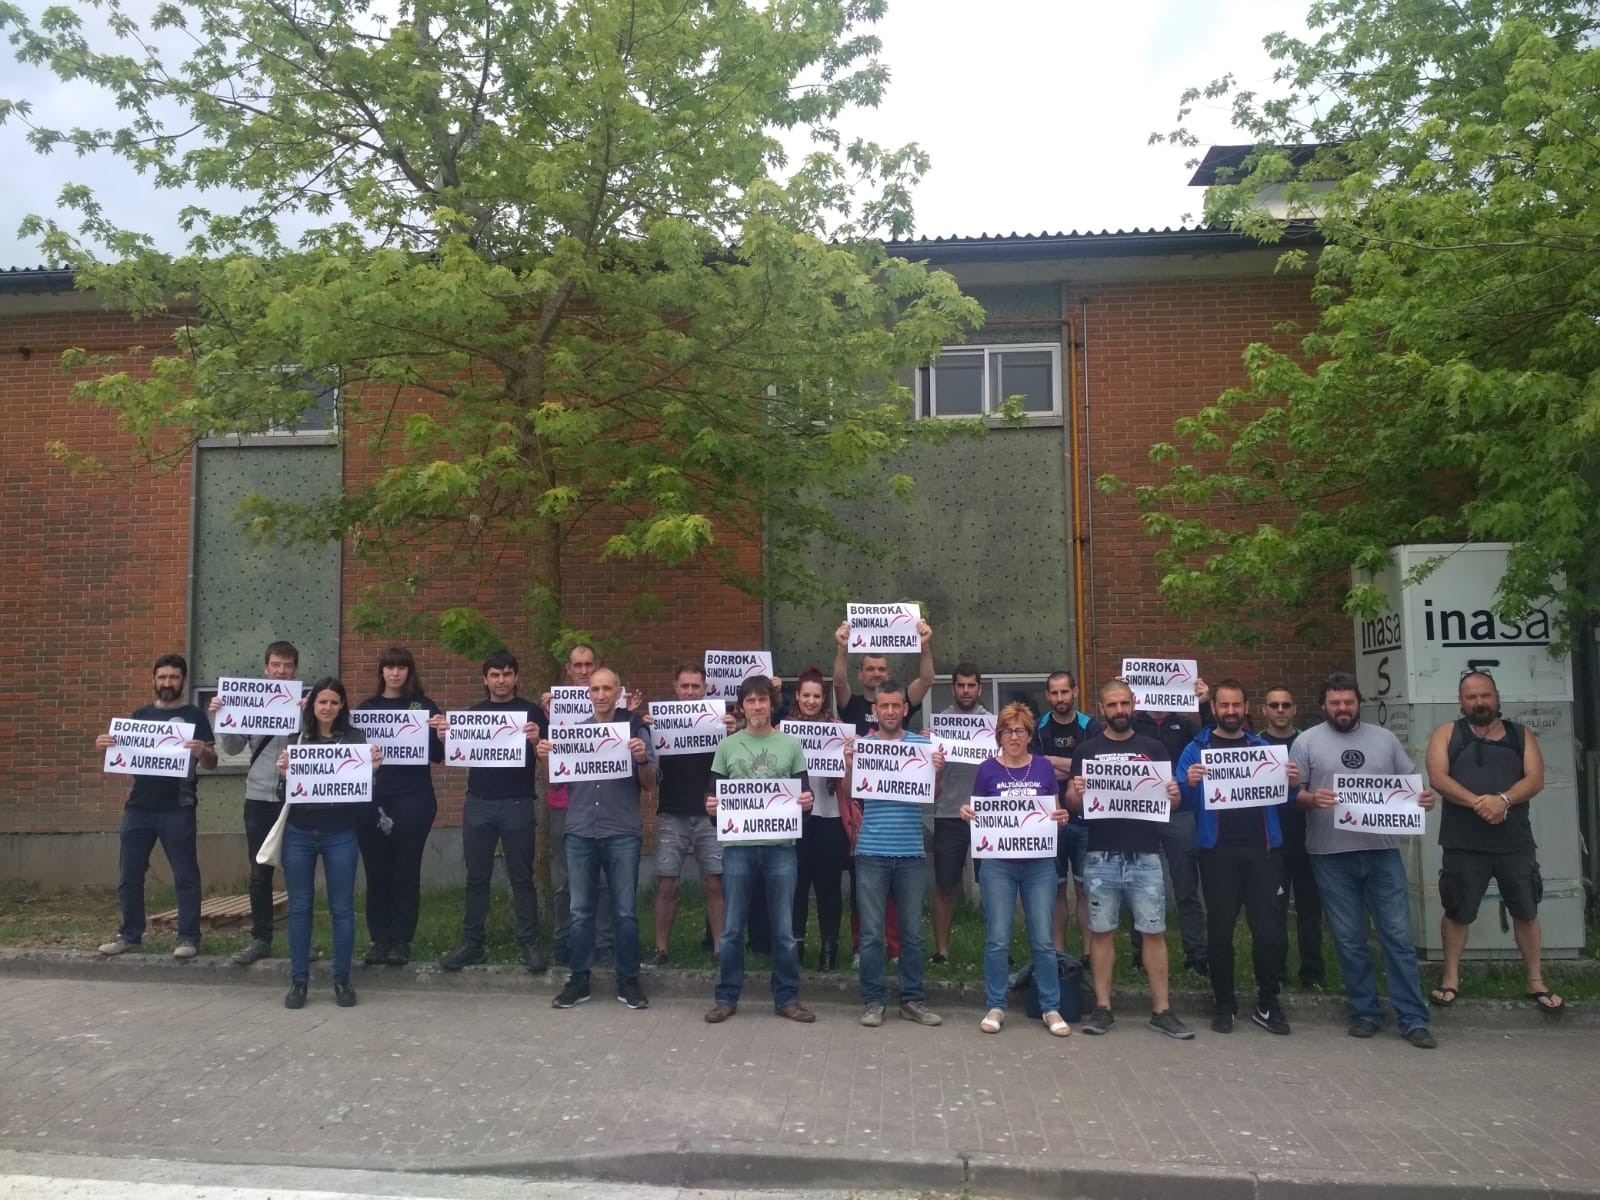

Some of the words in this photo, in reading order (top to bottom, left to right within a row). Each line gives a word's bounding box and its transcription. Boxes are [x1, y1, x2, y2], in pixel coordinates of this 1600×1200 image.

[851, 606, 902, 614] BORROKA
[851, 618, 888, 628] SINDIKALA
[870, 636, 917, 647] AURRERA!!
[708, 655, 756, 664] BORROKA
[707, 668, 742, 678] SINDIKALA
[1126, 662, 1180, 672] BORROKA
[1126, 675, 1164, 685] SINDIKALA
[222, 681, 281, 693] BORROKA
[554, 690, 590, 700] BORRO
[1145, 694, 1194, 706] AURRERA!!
[222, 695, 264, 708] SINDIKALA
[554, 704, 592, 714] SINDIKALA
[652, 704, 707, 715] BORROKA
[241, 716, 295, 729] AURRERA!!
[354, 714, 410, 723] BORROKA
[450, 714, 507, 725] BORROKA
[654, 718, 692, 730] SINDIKALA
[934, 717, 985, 727] BORROKA
[115, 721, 173, 735] BORROKA
[361, 728, 394, 738] NDIKALA
[450, 728, 491, 740] SINDIKALA
[552, 727, 610, 739] BORROKA
[784, 724, 837, 736] BORROKA
[934, 729, 970, 740] SINDIKALA
[113, 735, 155, 748] SINDIKALA
[290, 748, 352, 759] BORROKA
[380, 746, 424, 758] URRERA!!
[553, 742, 595, 754] SINDIKALA
[858, 743, 916, 756] BORROKA
[470, 749, 521, 760] AURRERA!!
[1205, 750, 1267, 764] BORROKA
[130, 754, 184, 771] AURRERA!!
[290, 762, 334, 775] SINDIKALA
[575, 760, 628, 774] AURRERA!!
[808, 758, 844, 771] URRERA
[857, 758, 899, 771] SINDIKALA
[1086, 764, 1149, 776] BORROKA
[1207, 767, 1251, 780] SINDIKALA
[720, 782, 781, 794] BORROKA
[877, 782, 930, 796] AURRERA!!
[1087, 778, 1132, 791] SINDIKALA
[1338, 778, 1402, 788] BORROKA
[312, 783, 367, 796] AURRERA!!
[1231, 785, 1285, 801] AURRERA!!
[721, 798, 764, 810] SINDIKALA
[1338, 792, 1384, 804] SINDIKALA
[974, 800, 1035, 811] BORROKA
[1109, 799, 1166, 814] AURRERA!!
[743, 818, 798, 832] AURRERA!!
[975, 816, 1019, 828] SINDIKALA
[1362, 814, 1420, 827] AURRERA!!
[998, 837, 1053, 851] AURRERA!!
